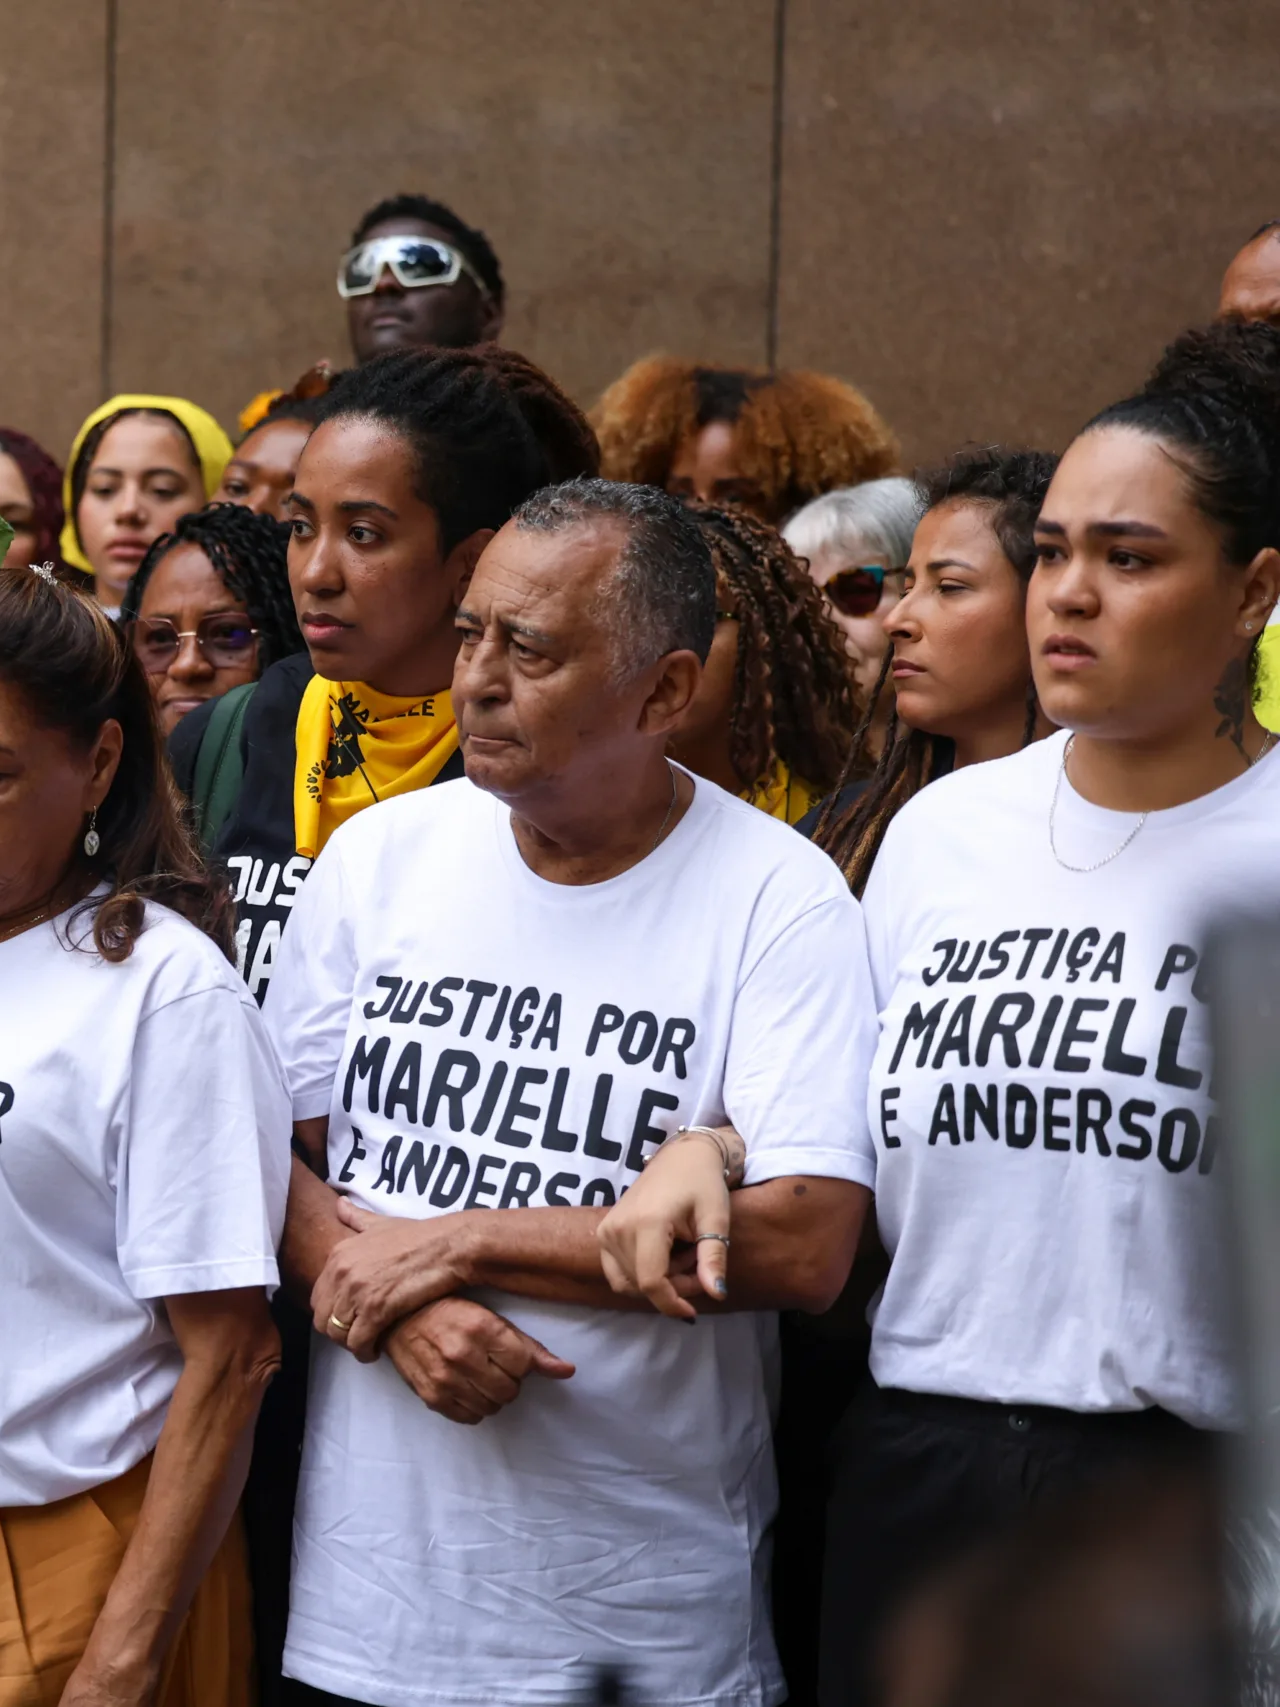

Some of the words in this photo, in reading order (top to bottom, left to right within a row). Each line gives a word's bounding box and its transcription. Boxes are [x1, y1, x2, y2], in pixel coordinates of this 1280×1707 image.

[922, 927, 1126, 986] JUSTIÇA
[363, 975, 563, 1051] JUSTIÇA
[585, 1003, 695, 1080] POR
[888, 992, 1209, 1092] MARIELL
[343, 1035, 680, 1173] MARIELLE
[880, 1086, 901, 1149] E
[339, 1126, 367, 1183] E
[371, 1135, 628, 1211] ANDERSO
